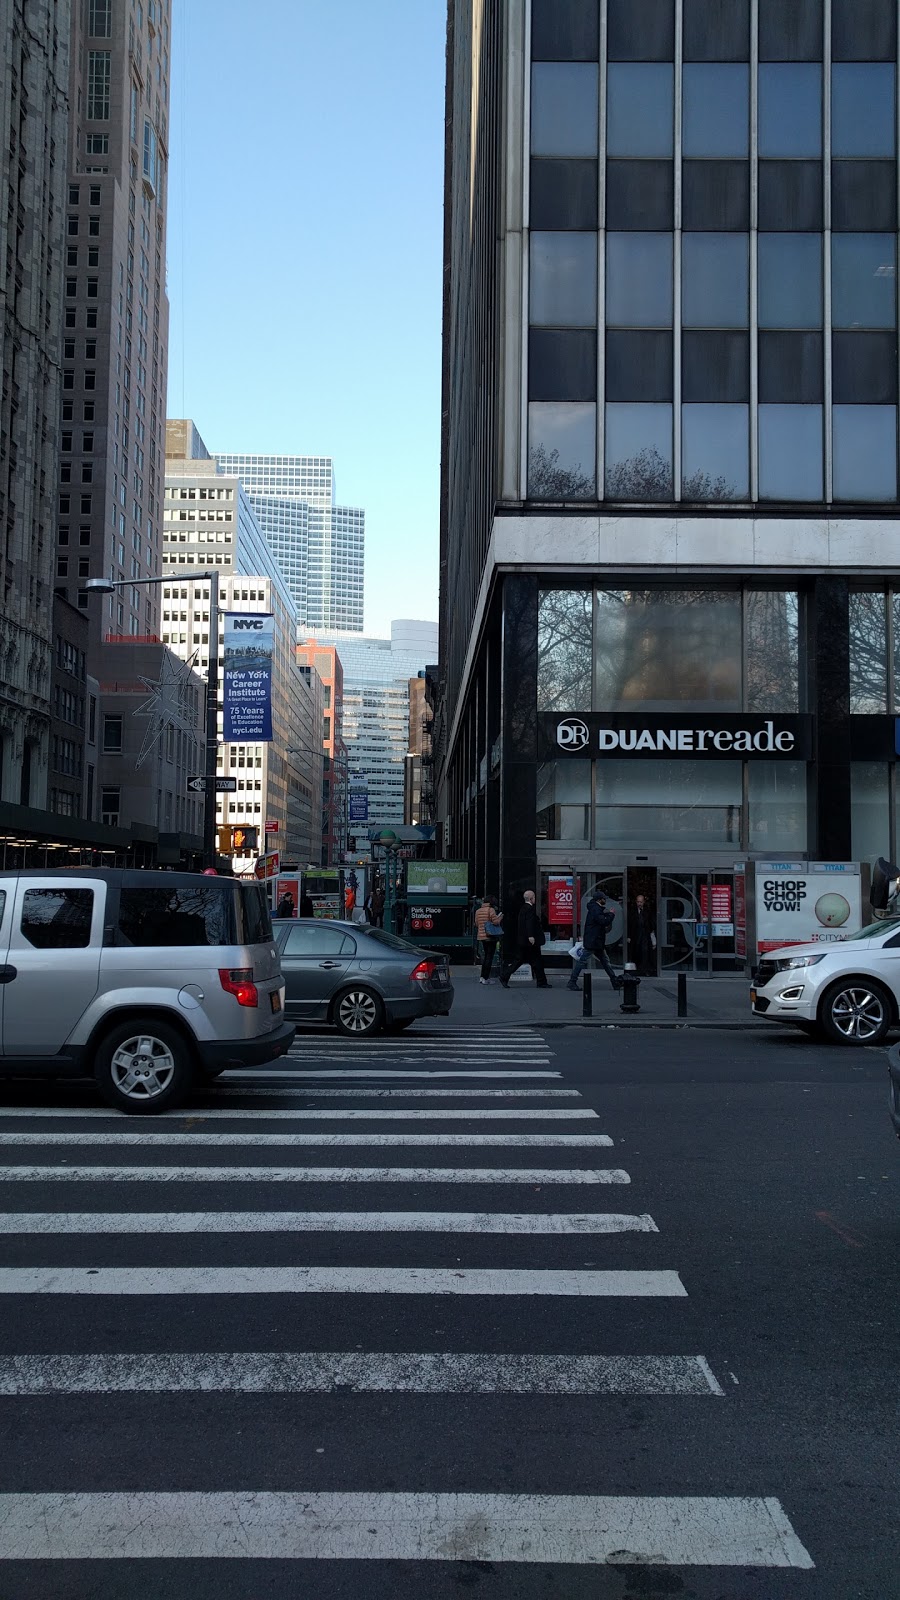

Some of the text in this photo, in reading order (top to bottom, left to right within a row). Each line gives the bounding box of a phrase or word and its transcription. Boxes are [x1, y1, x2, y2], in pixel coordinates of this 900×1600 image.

[233, 619, 263, 630] NYC
[226, 671, 269, 679] New York
[232, 680, 262, 688] Career
[228, 689, 266, 697] Institute
[230, 706, 265, 715] 75 Years
[232, 726, 263, 735] nyci.edu
[557, 725, 590, 745] DR
[599, 720, 795, 752] DUANE reade
[763, 880, 807, 891] CHOP
[555, 892, 573, 902] $20
[763, 891, 807, 902] CHOP
[763, 901, 801, 912] YOW!
[414, 920, 431, 928] 2 3
